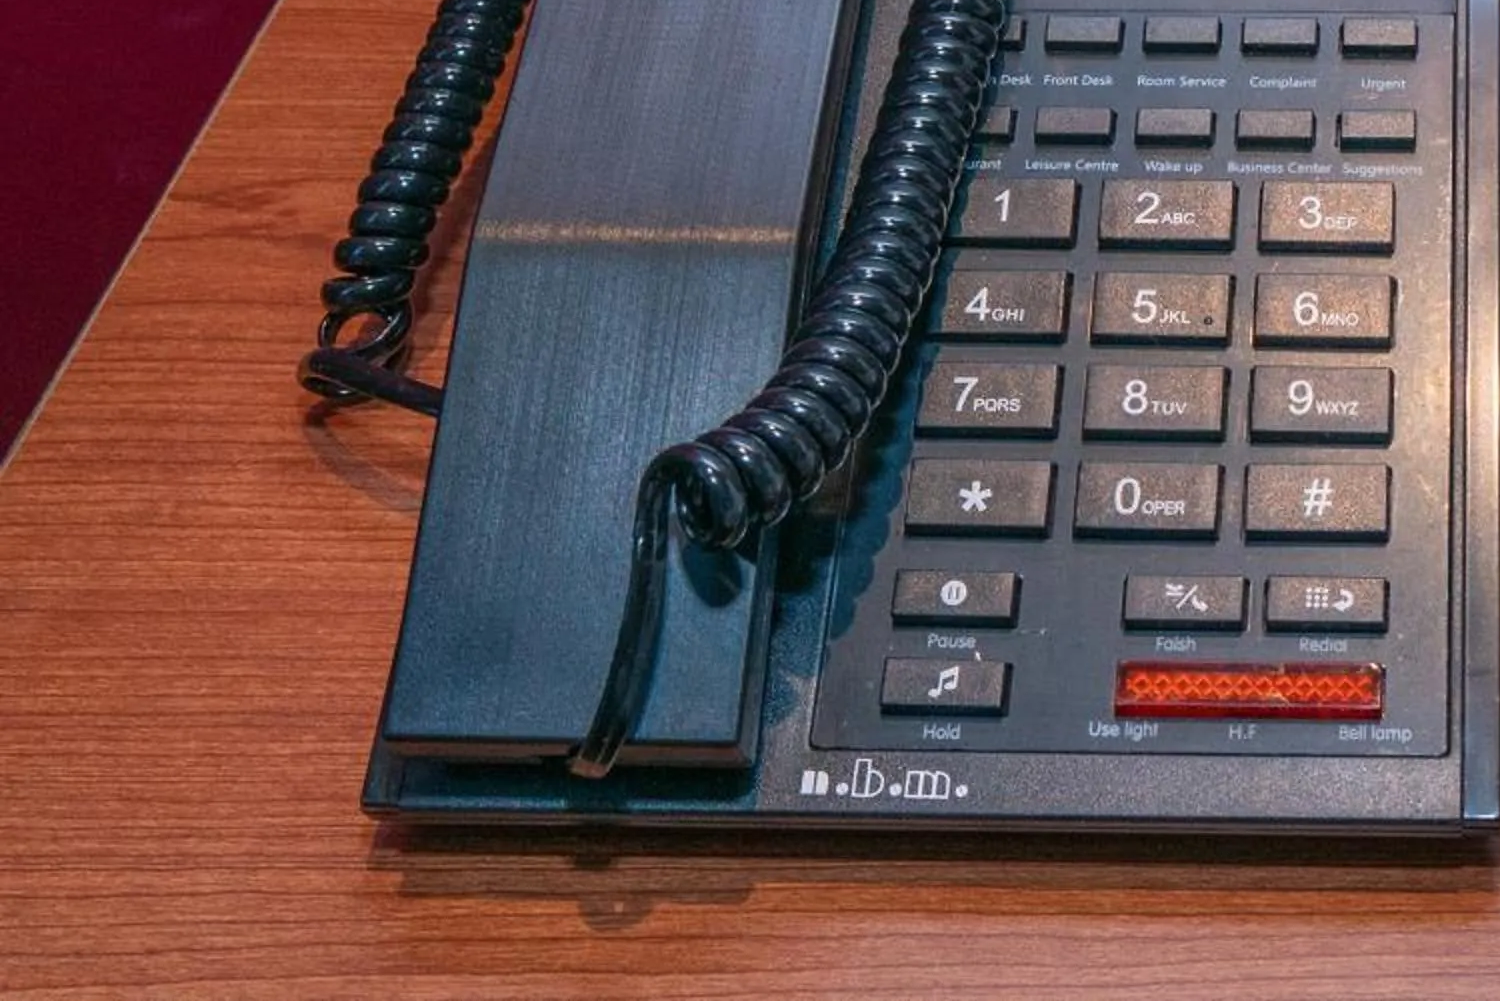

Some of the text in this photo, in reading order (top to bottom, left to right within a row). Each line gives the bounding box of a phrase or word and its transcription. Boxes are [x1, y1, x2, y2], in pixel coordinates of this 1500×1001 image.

[1001, 74, 1033, 86] Desk
[1043, 75, 1114, 86] Front Desk
[1137, 76, 1227, 88] Room Service
[1249, 76, 1317, 90] Complaint
[1361, 77, 1407, 92] Urgent
[1025, 159, 1120, 172] Leisure Centre
[1144, 160, 1203, 174] Wake up
[1227, 161, 1333, 174] Business Center
[1342, 162, 1424, 177] Suggestions
[994, 189, 1011, 222] 1
[1134, 191, 1196, 225] 2 ABC
[1299, 196, 1322, 229] 3
[964, 286, 1026, 323] 4 GHI
[1131, 289, 1191, 325] 5 JKL
[1294, 292, 1360, 327] 6 MNO
[953, 377, 1022, 414] 7 PQRS
[1122, 380, 1188, 416] 8 TUV
[1288, 380, 1360, 417] 9 WXYZ
[1114, 478, 1185, 516] 0 OPER
[927, 634, 976, 650] Pause
[1299, 636, 1348, 653] Redial
[922, 723, 962, 741] Hold
[1088, 721, 1158, 741] Use light
[1338, 726, 1413, 744] Bell lamp
